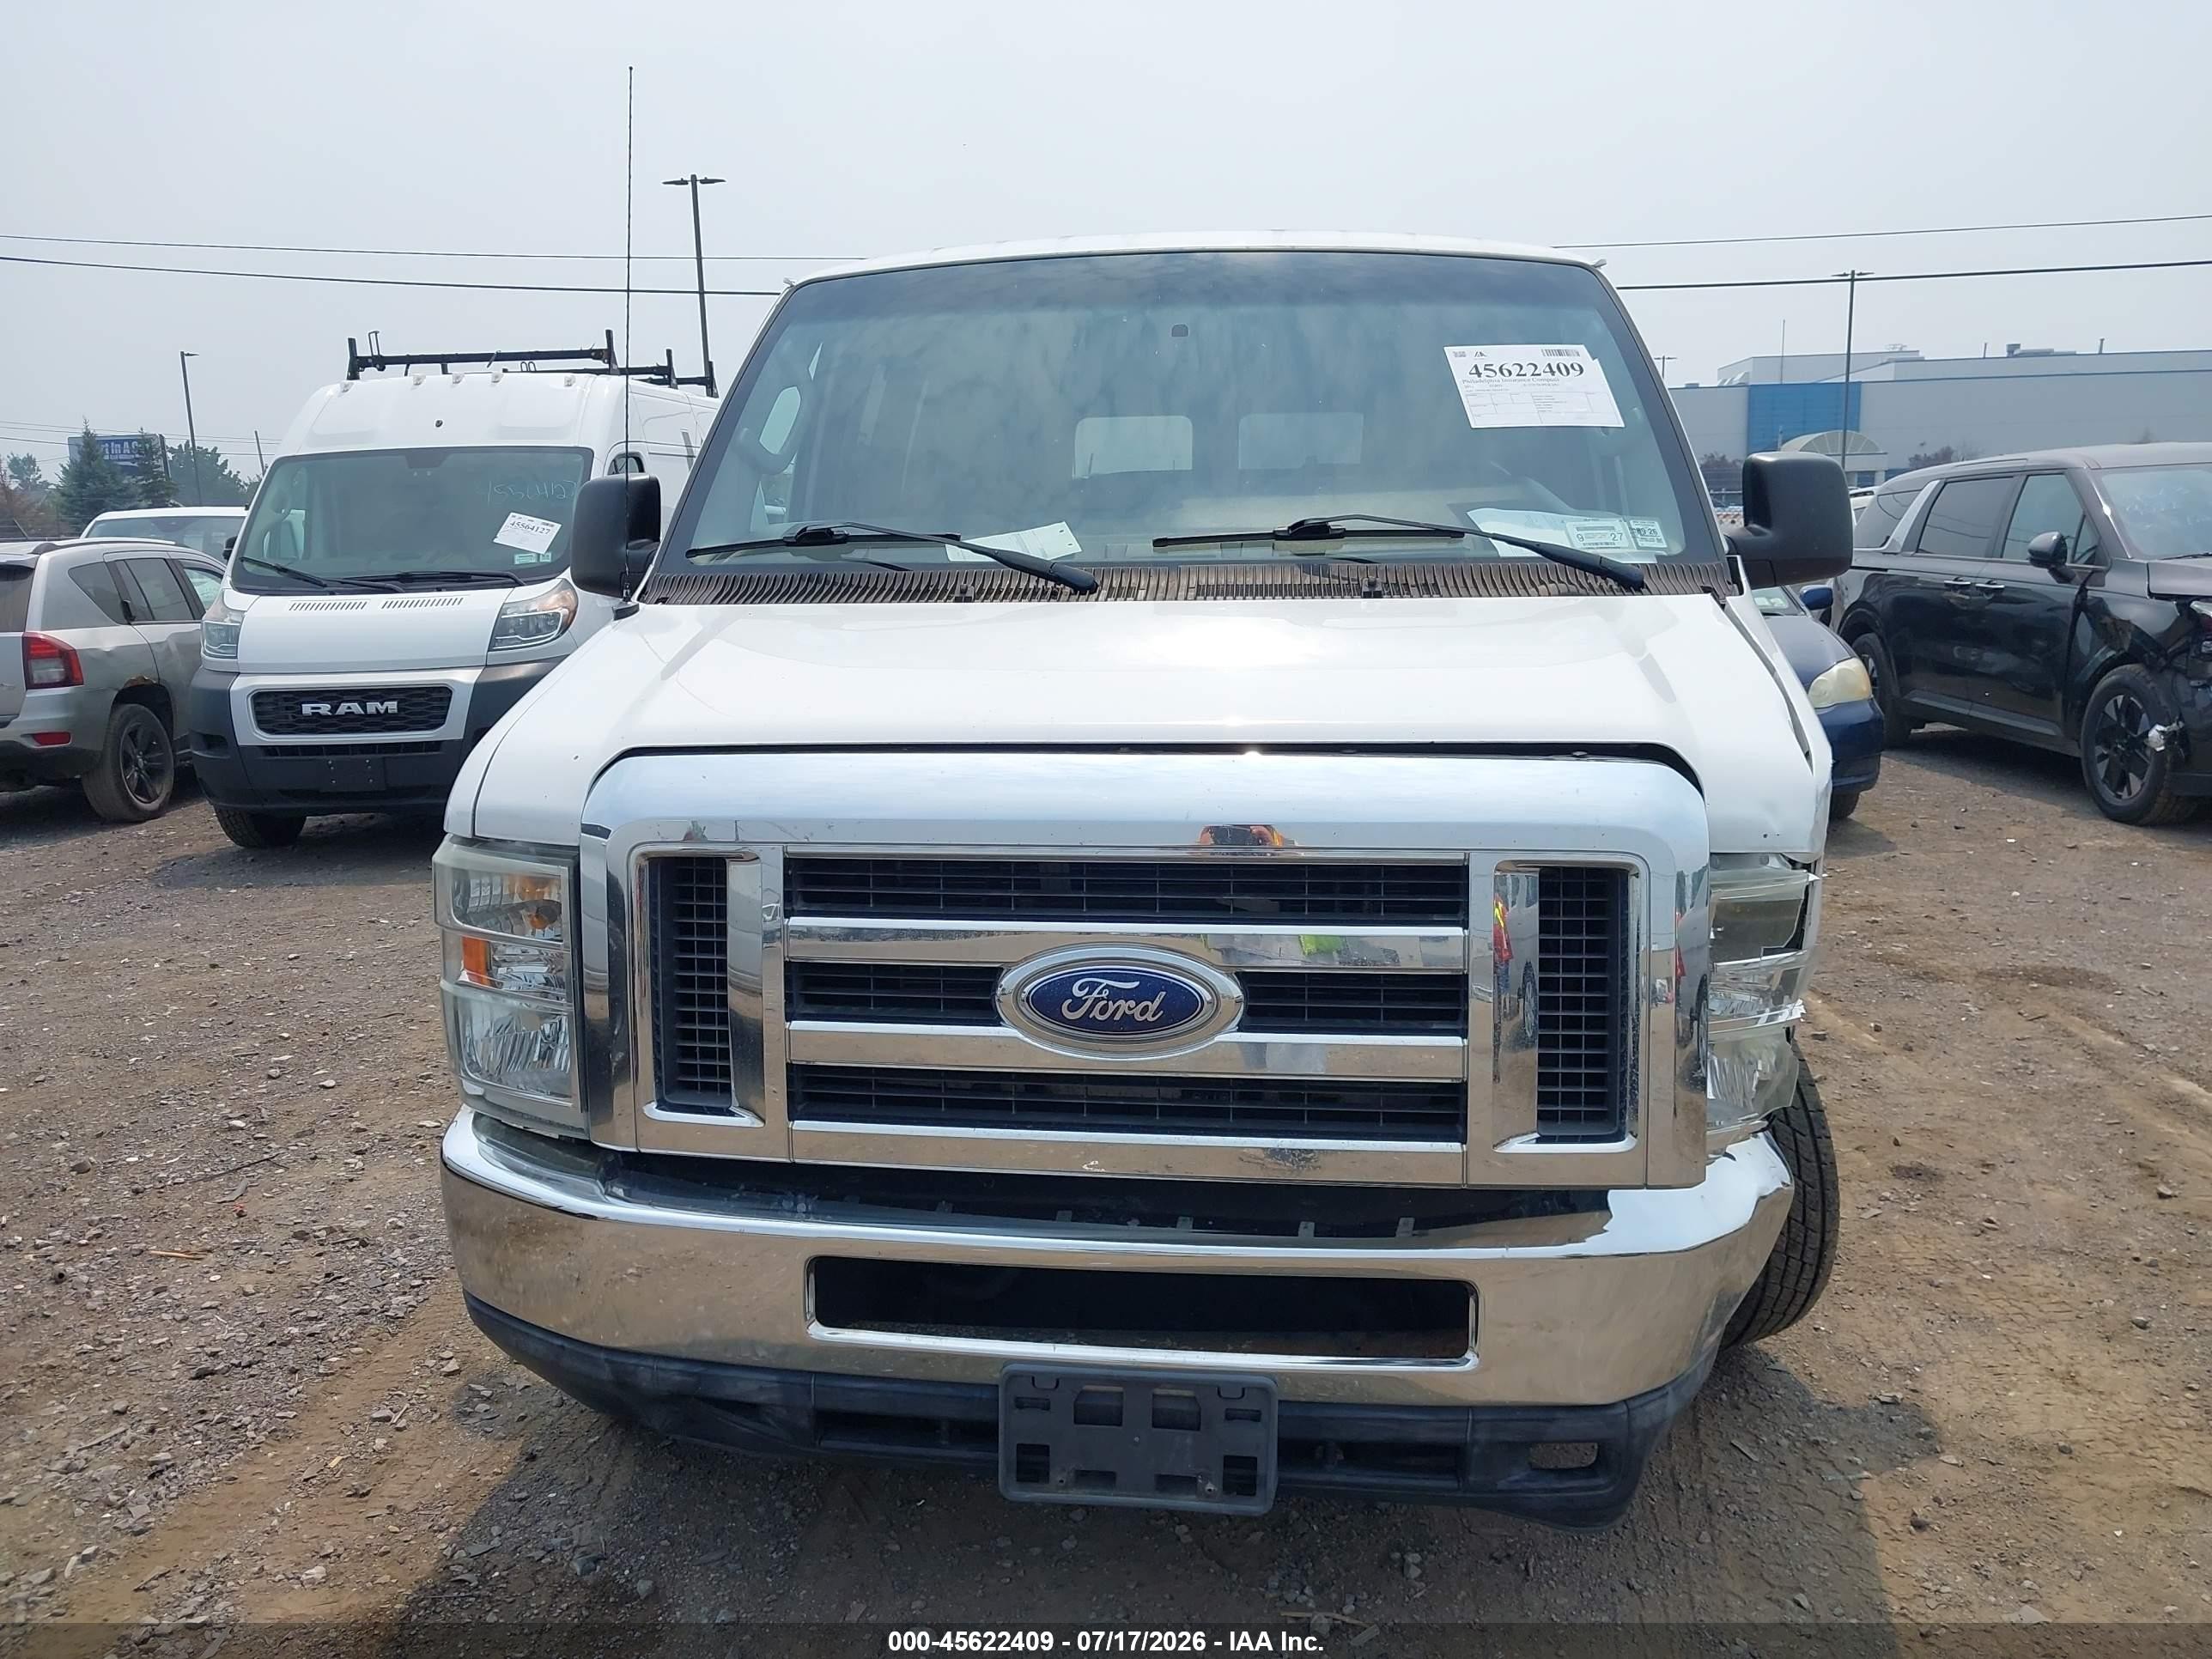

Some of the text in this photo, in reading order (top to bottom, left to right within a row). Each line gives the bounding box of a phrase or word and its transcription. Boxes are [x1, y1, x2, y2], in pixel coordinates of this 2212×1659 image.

[1469, 362, 1584, 379] 45622409
[509, 520, 551, 535] 45564127
[1610, 532, 1623, 542] 27
[301, 701, 398, 716] RAM
[1061, 977, 1167, 1022] Ford
